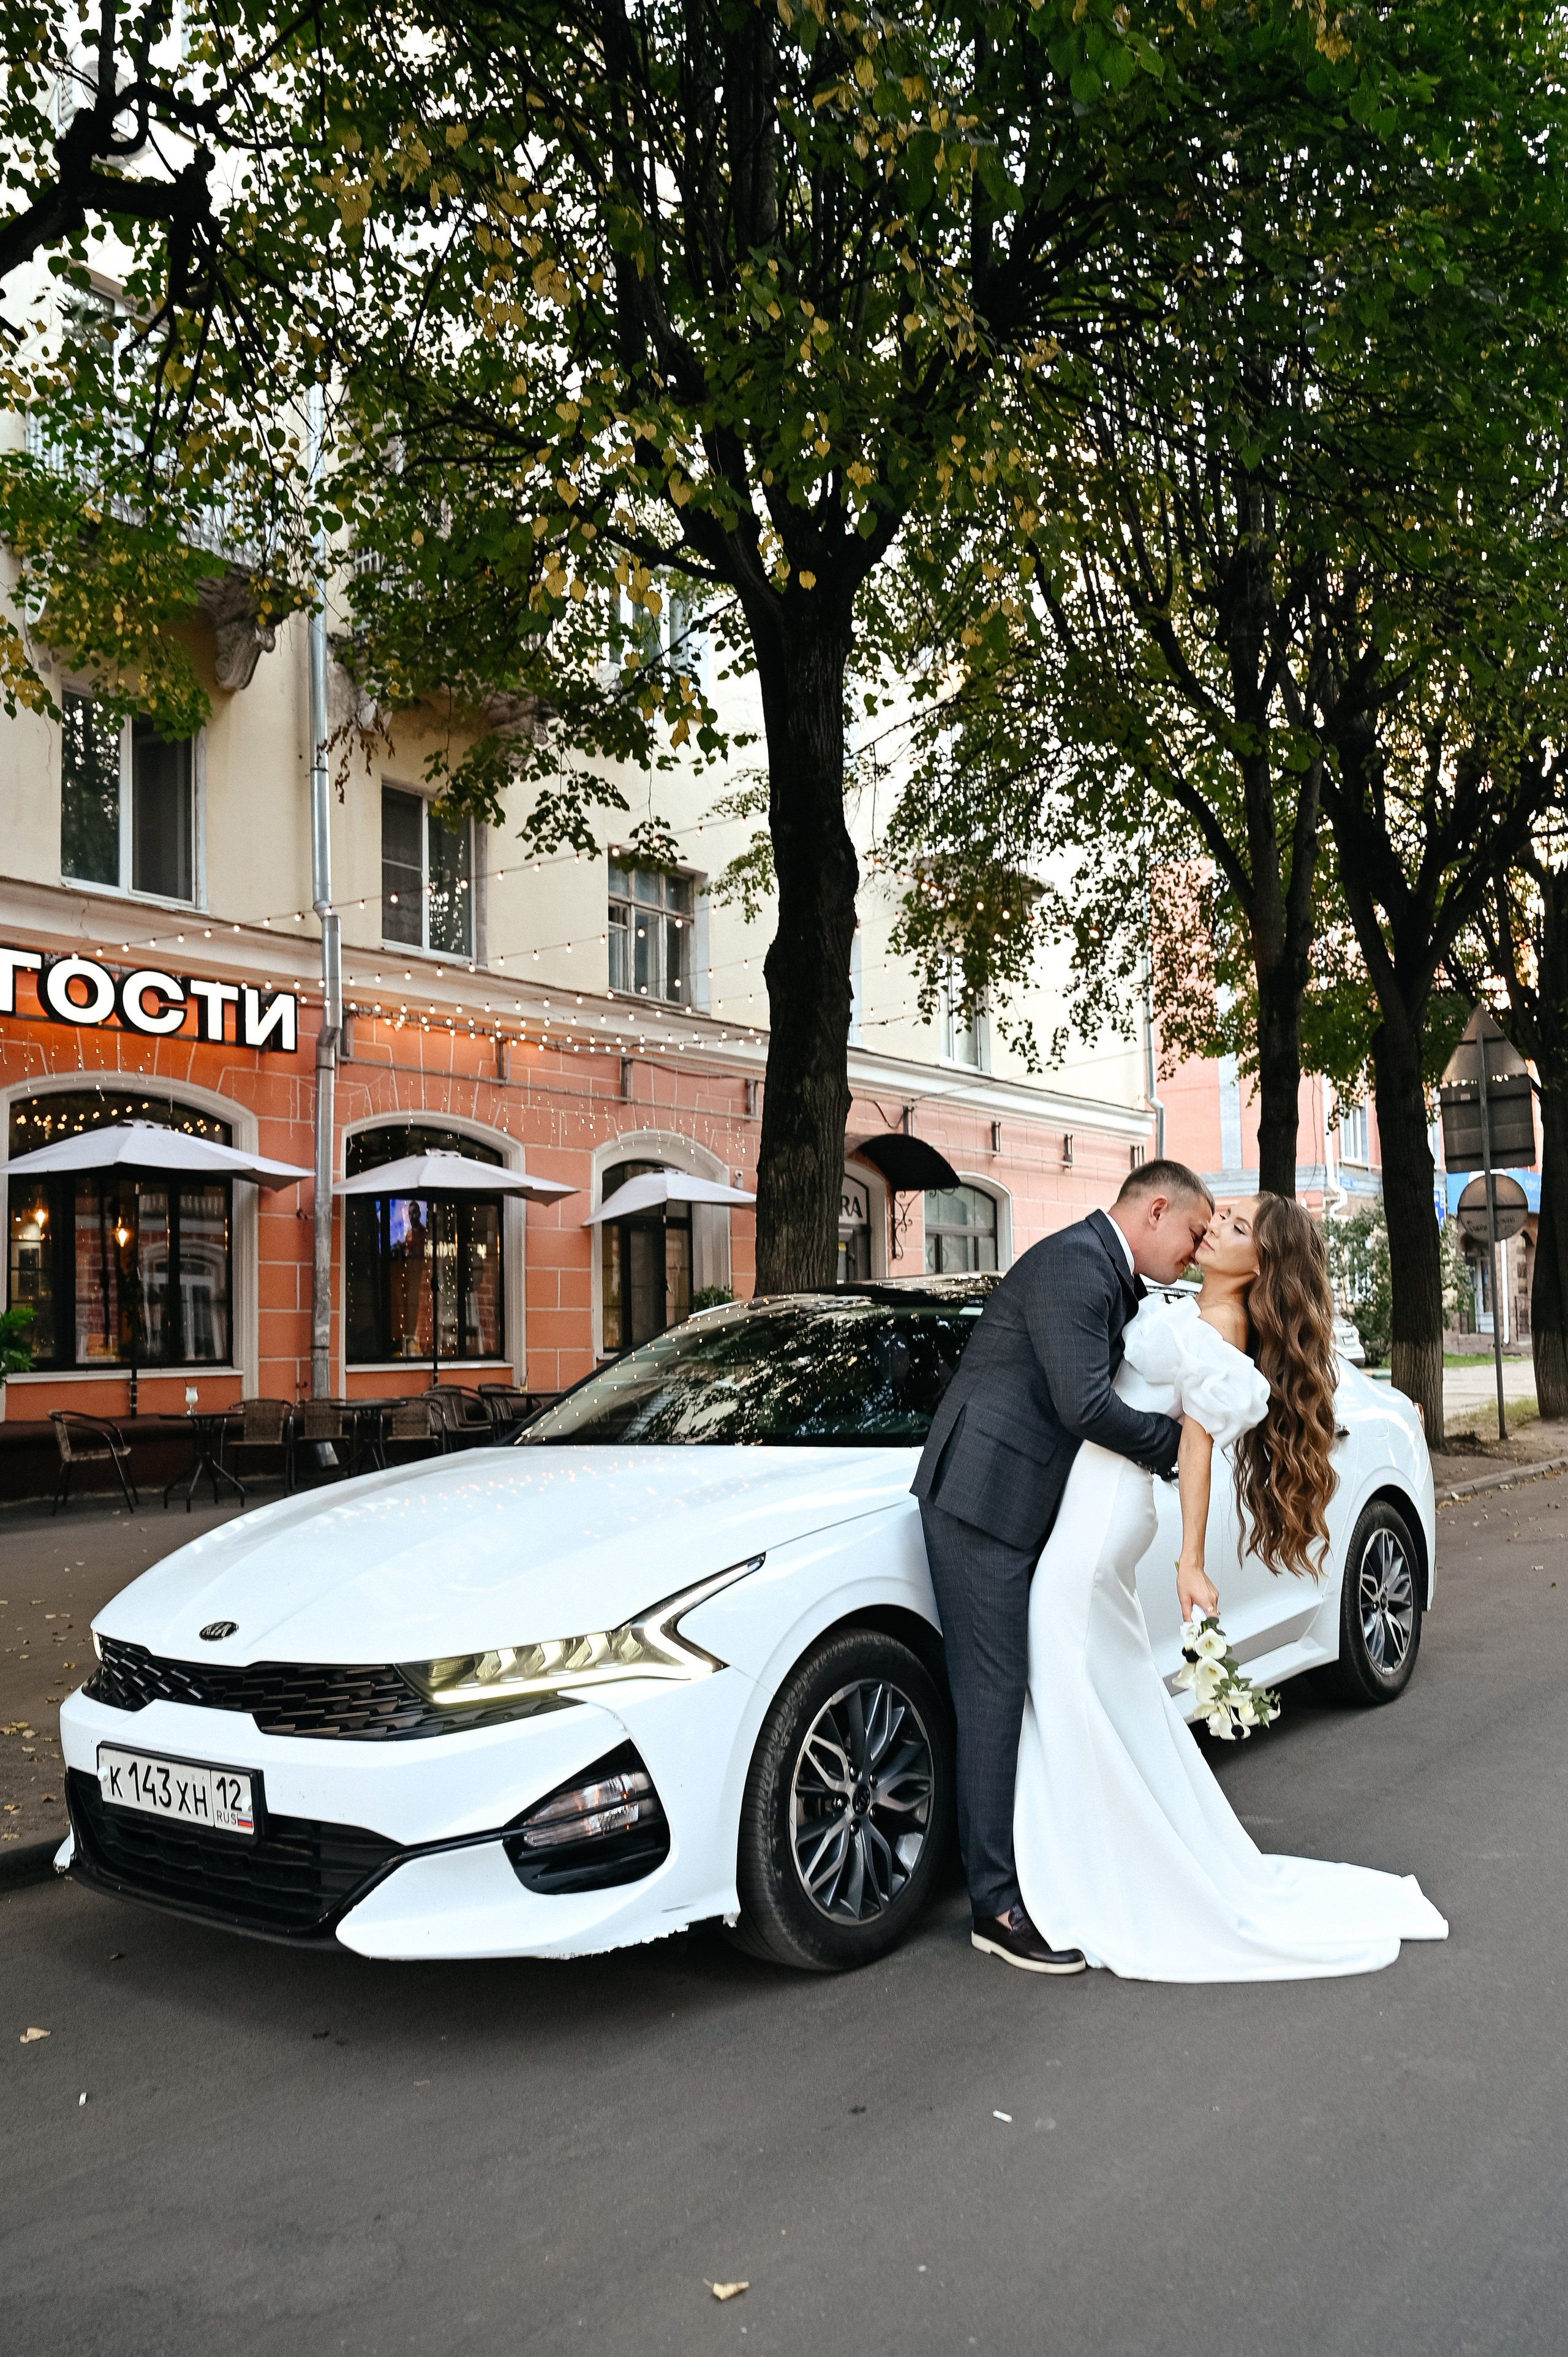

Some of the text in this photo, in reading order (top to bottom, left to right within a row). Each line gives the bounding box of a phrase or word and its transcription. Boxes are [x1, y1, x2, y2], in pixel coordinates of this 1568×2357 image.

[0, 948, 295, 1050] ГОСТИ
[216, 1778, 242, 1811] 12
[217, 1811, 236, 1825] RUS
